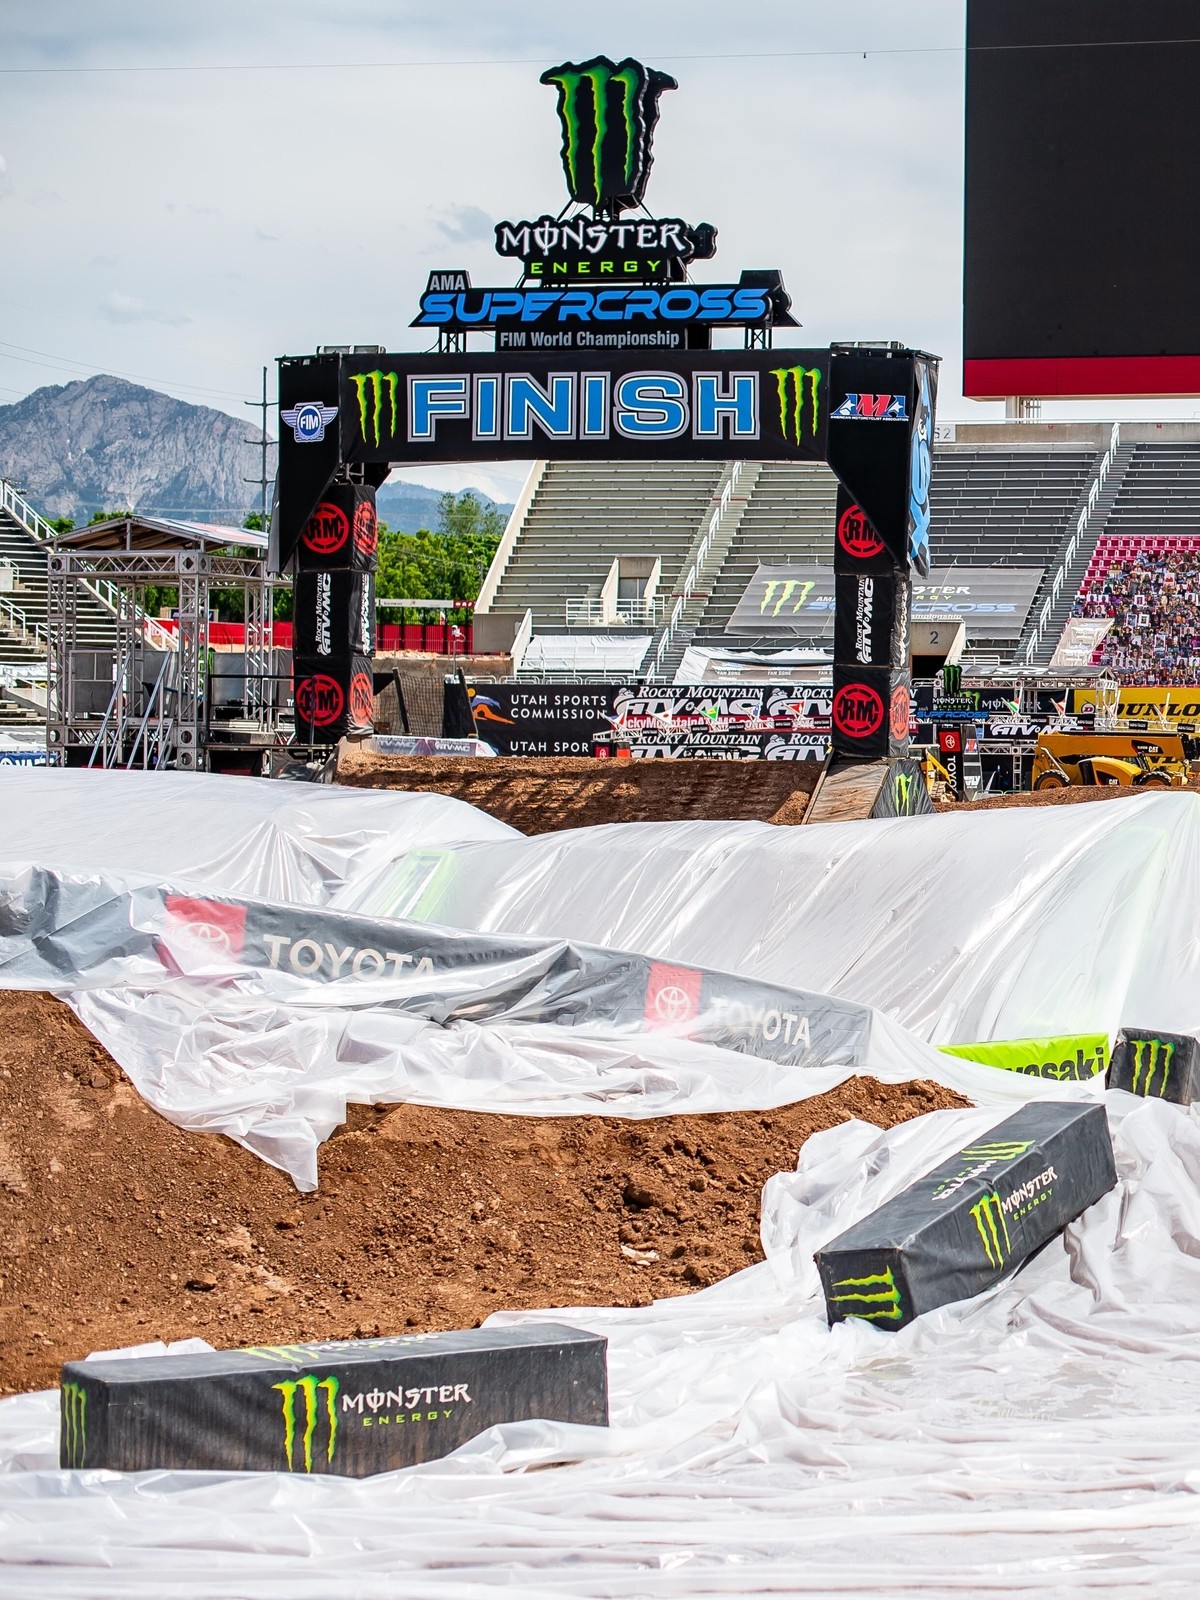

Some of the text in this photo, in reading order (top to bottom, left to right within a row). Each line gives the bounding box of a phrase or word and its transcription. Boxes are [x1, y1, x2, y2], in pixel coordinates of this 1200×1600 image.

[501, 221, 686, 256] MONSTER
[530, 260, 664, 275] ENERGY
[429, 274, 467, 291] AMA
[418, 287, 772, 323] SUPERCROSS
[500, 330, 680, 349] FIM World Championship
[406, 369, 761, 442] FINISH
[830, 393, 909, 418] AMA
[299, 414, 319, 430] FIM
[929, 631, 939, 644] 2
[510, 695, 608, 706] UTAH SPORTS
[637, 686, 764, 698] ROCKY MOUNTAIN
[510, 708, 607, 720] COMMISSION
[510, 741, 590, 752] UTAH SPOR
[683, 733, 762, 745] MOUNTAIN
[263, 933, 435, 982] TOYOTA
[1000, 1166, 1059, 1214] MONSTER
[1013, 1188, 1054, 1221] ENERGY
[342, 1383, 472, 1414] MONSTER
[363, 1409, 454, 1427] ENERGY
